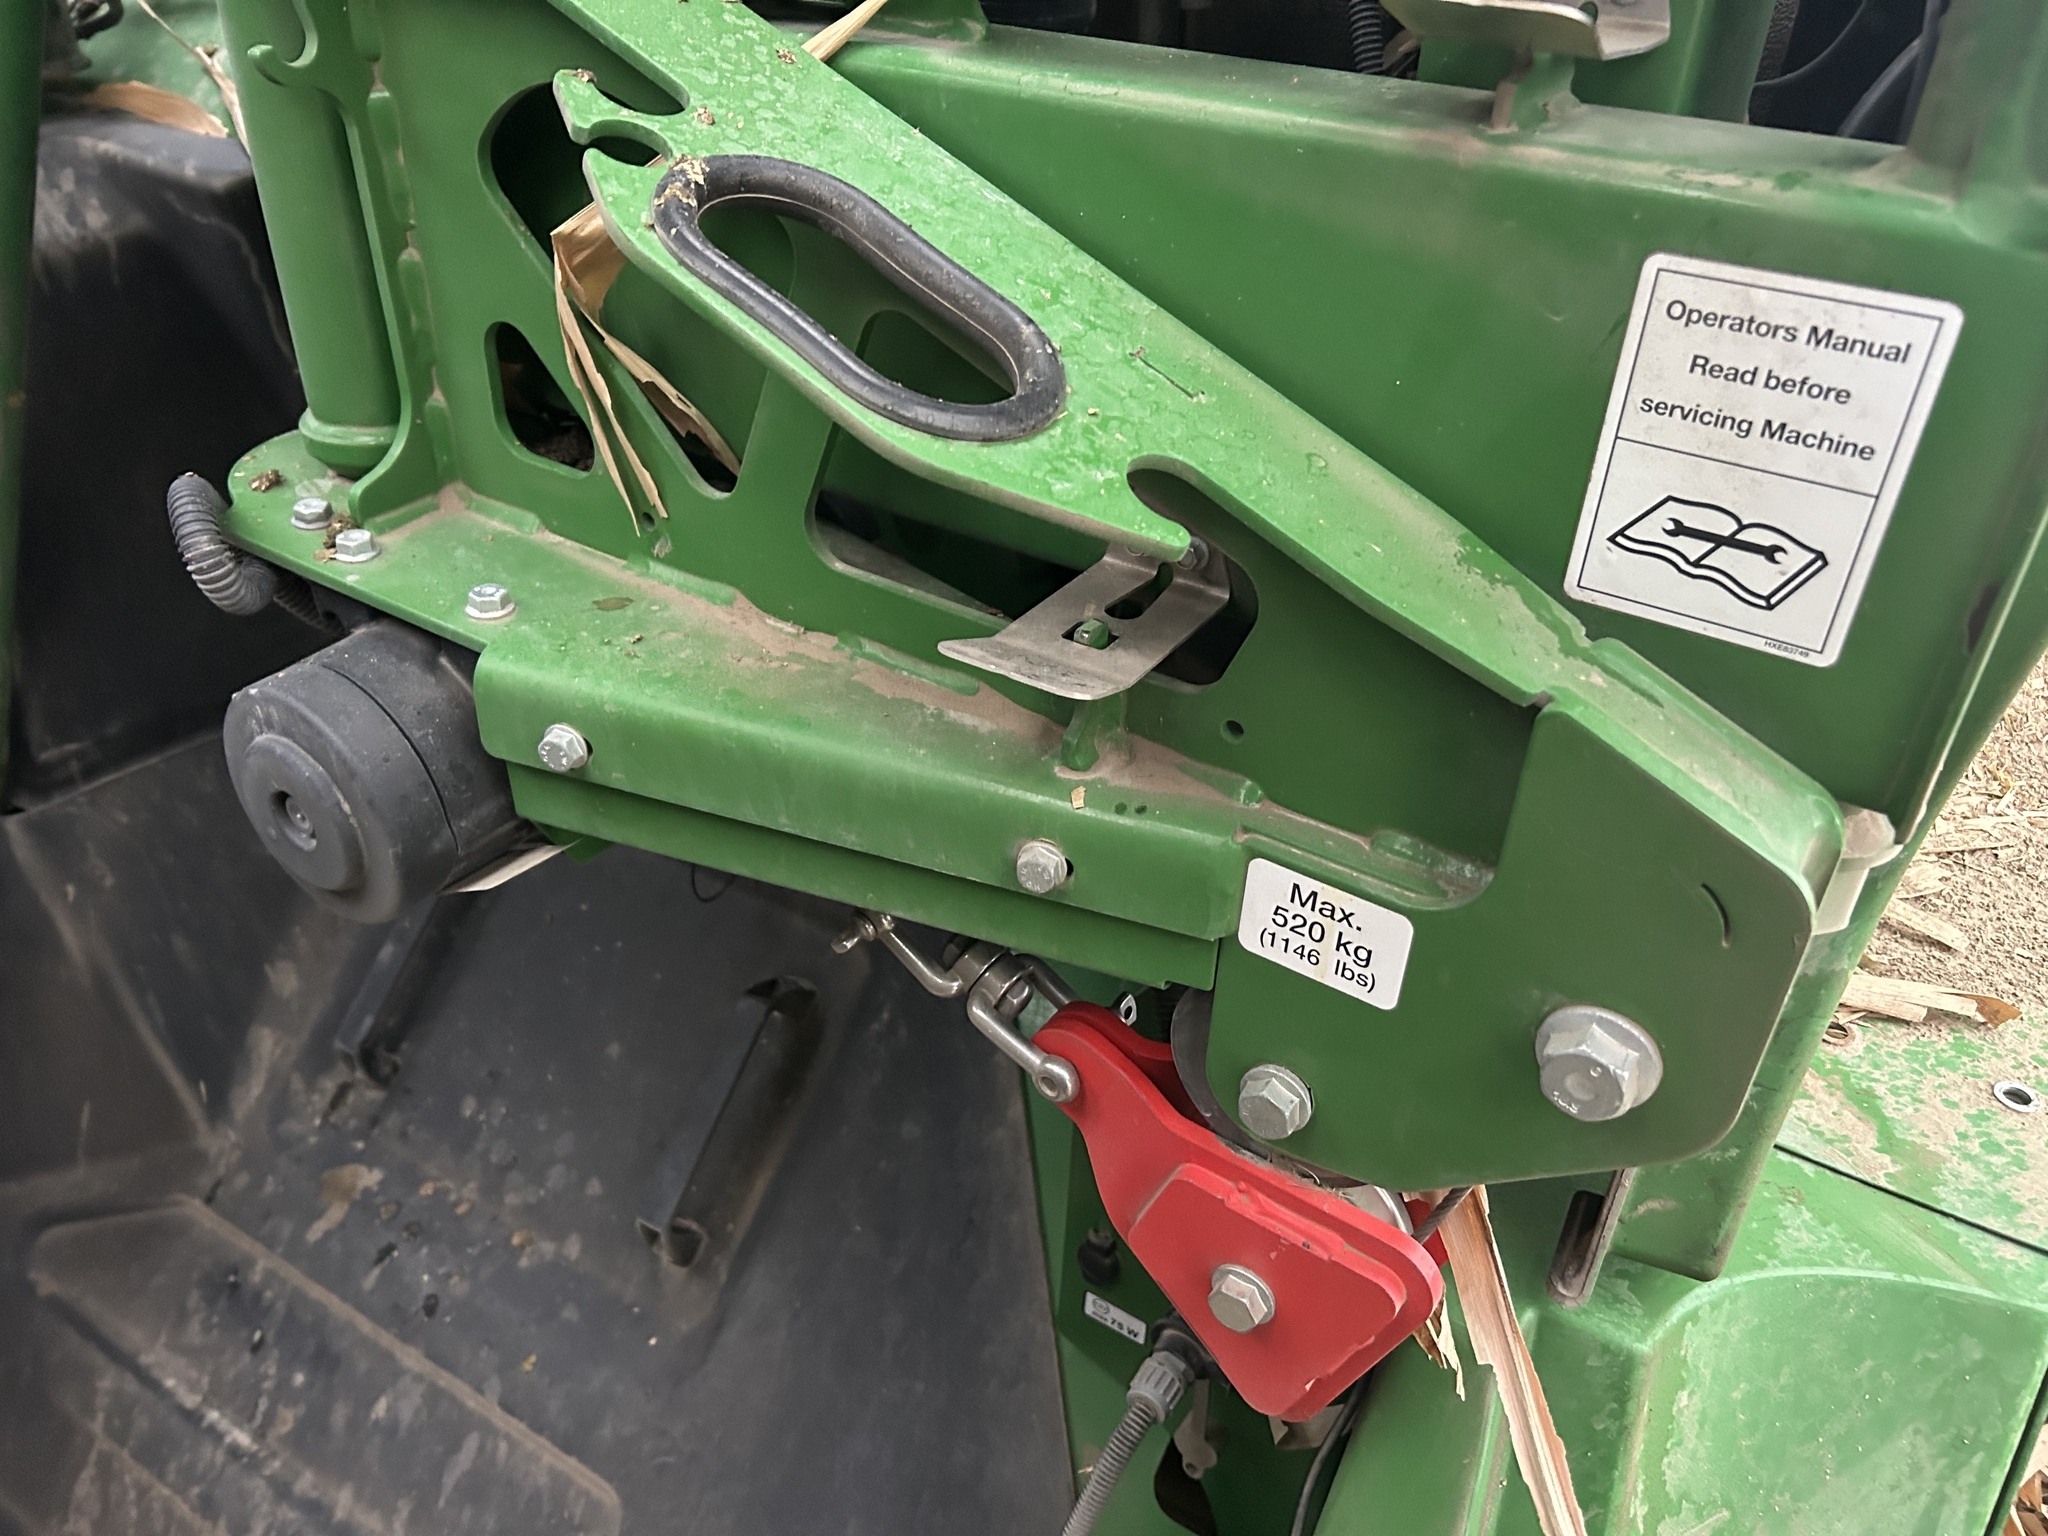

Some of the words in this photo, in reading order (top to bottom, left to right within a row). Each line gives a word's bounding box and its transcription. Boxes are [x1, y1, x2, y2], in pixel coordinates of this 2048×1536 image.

[1665, 299, 1798, 343] Operators
[1805, 325, 1912, 363] Manual
[1688, 354, 1757, 386] Read
[1763, 369, 1851, 405] before
[1639, 397, 1753, 438] servicing
[1759, 419, 1875, 461] Machine
[1271, 905, 1325, 943] 520
[1335, 931, 1373, 969] kg
[1289, 882, 1362, 931] Max.
[1259, 927, 1321, 966] (1146
[1334, 959, 1376, 993] lbs)
